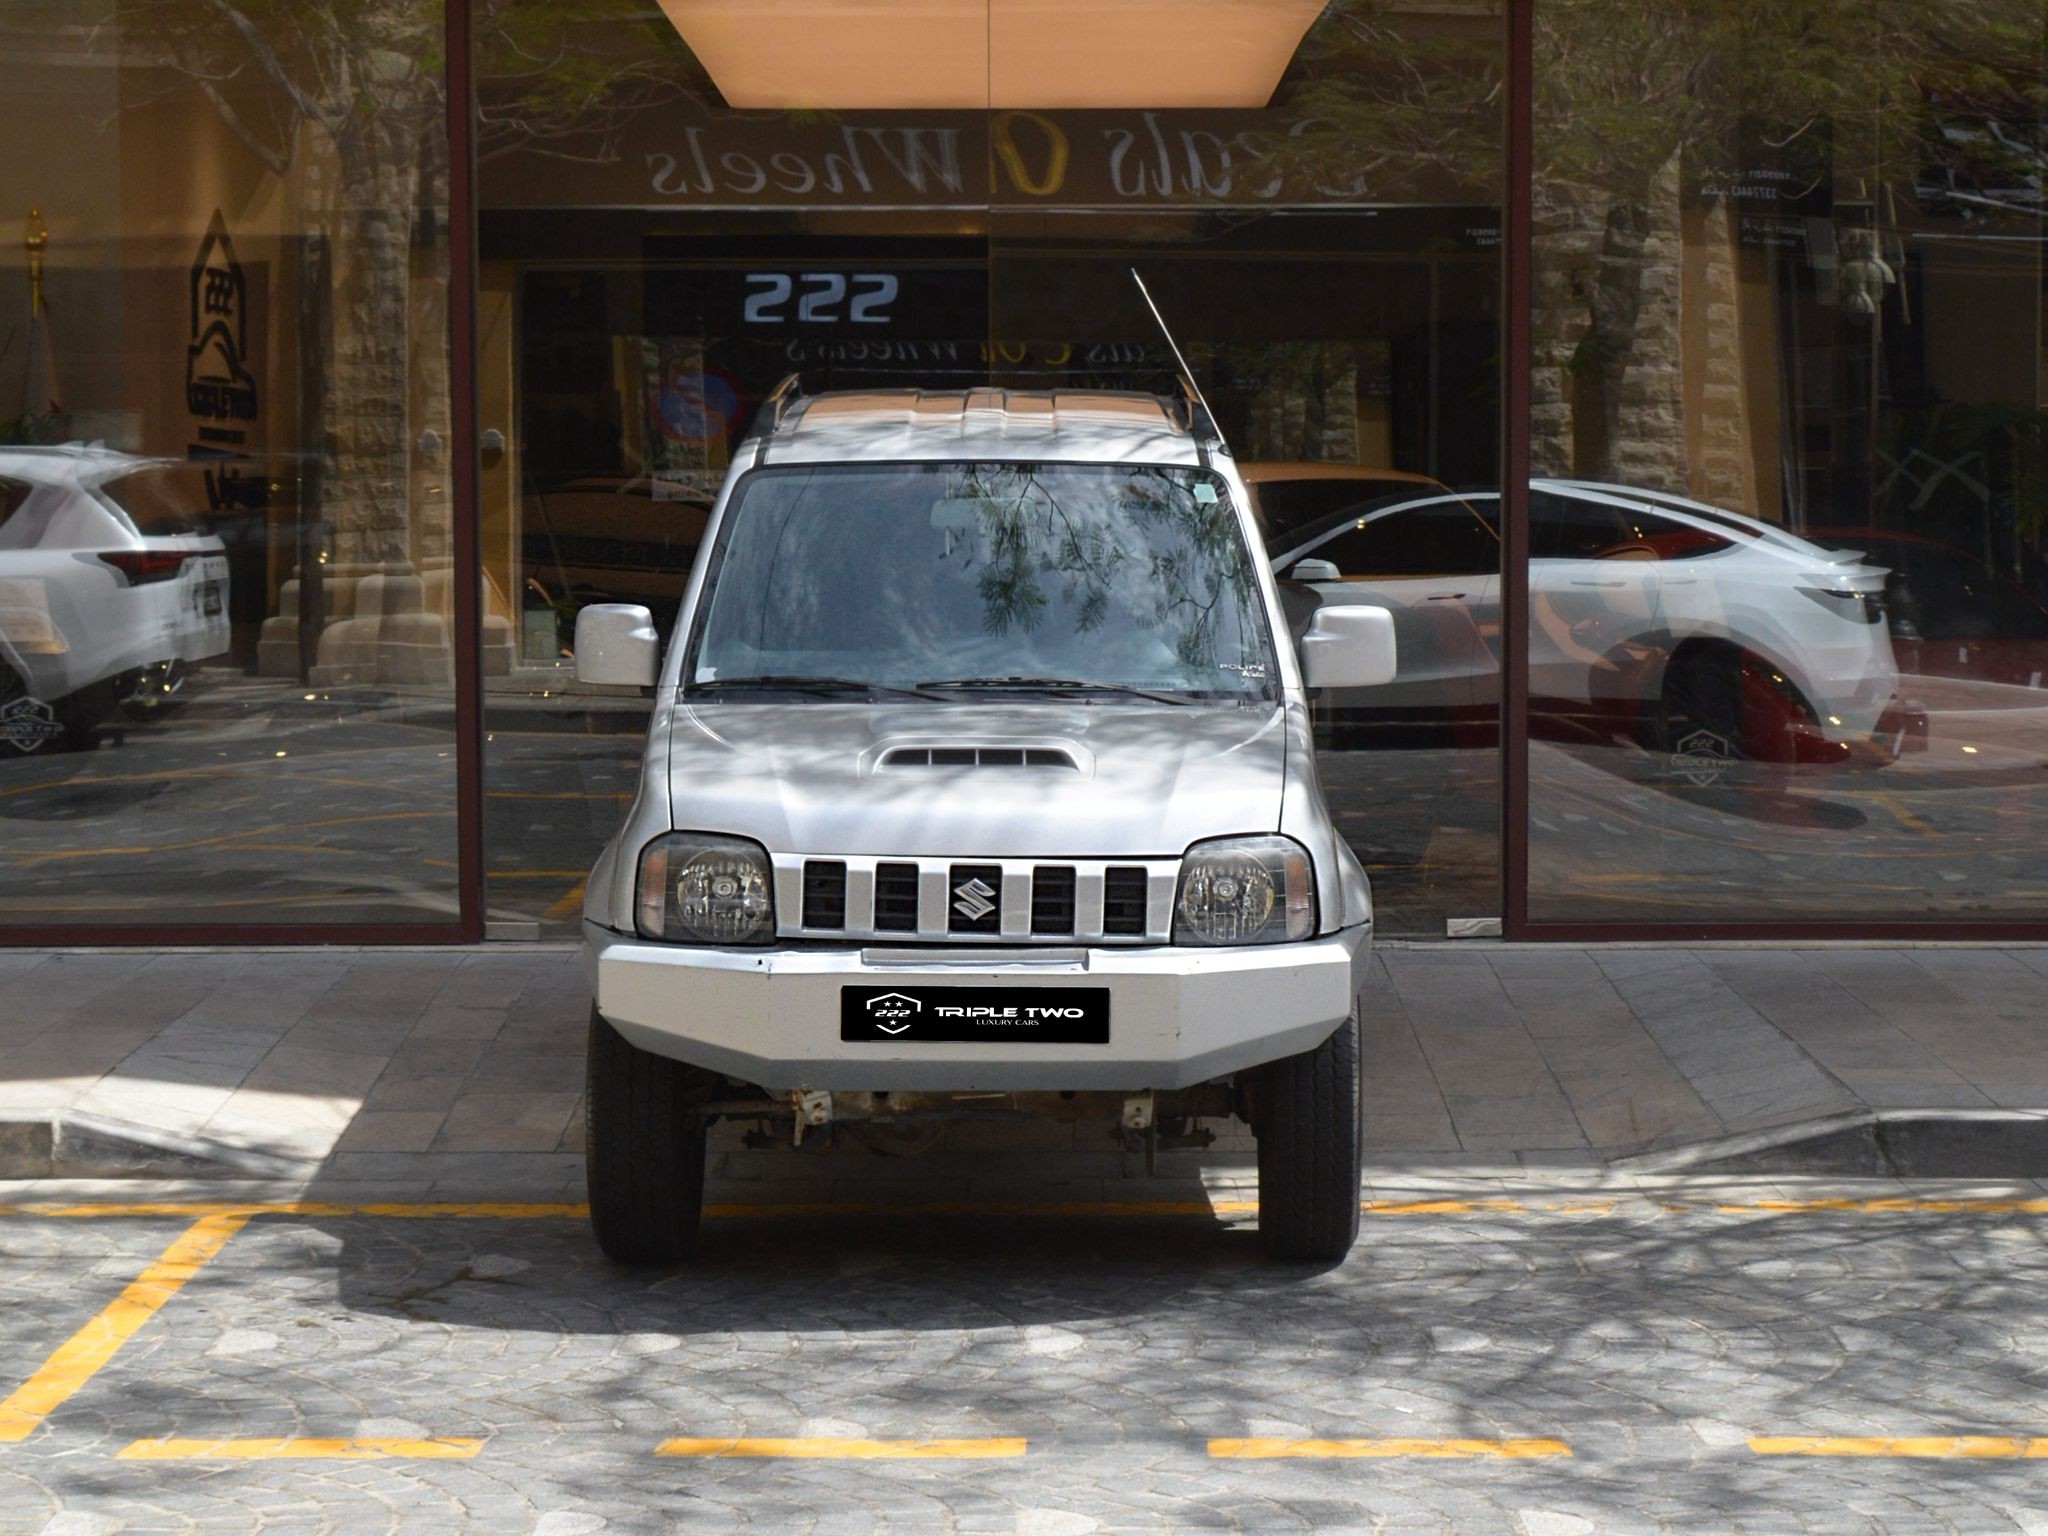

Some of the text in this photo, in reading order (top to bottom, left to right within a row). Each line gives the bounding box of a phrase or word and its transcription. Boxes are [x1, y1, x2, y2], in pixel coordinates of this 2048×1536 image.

[744, 273, 899, 322] 222
[874, 1009, 911, 1017] 222
[934, 1006, 1084, 1018] TRIPLE TWO
